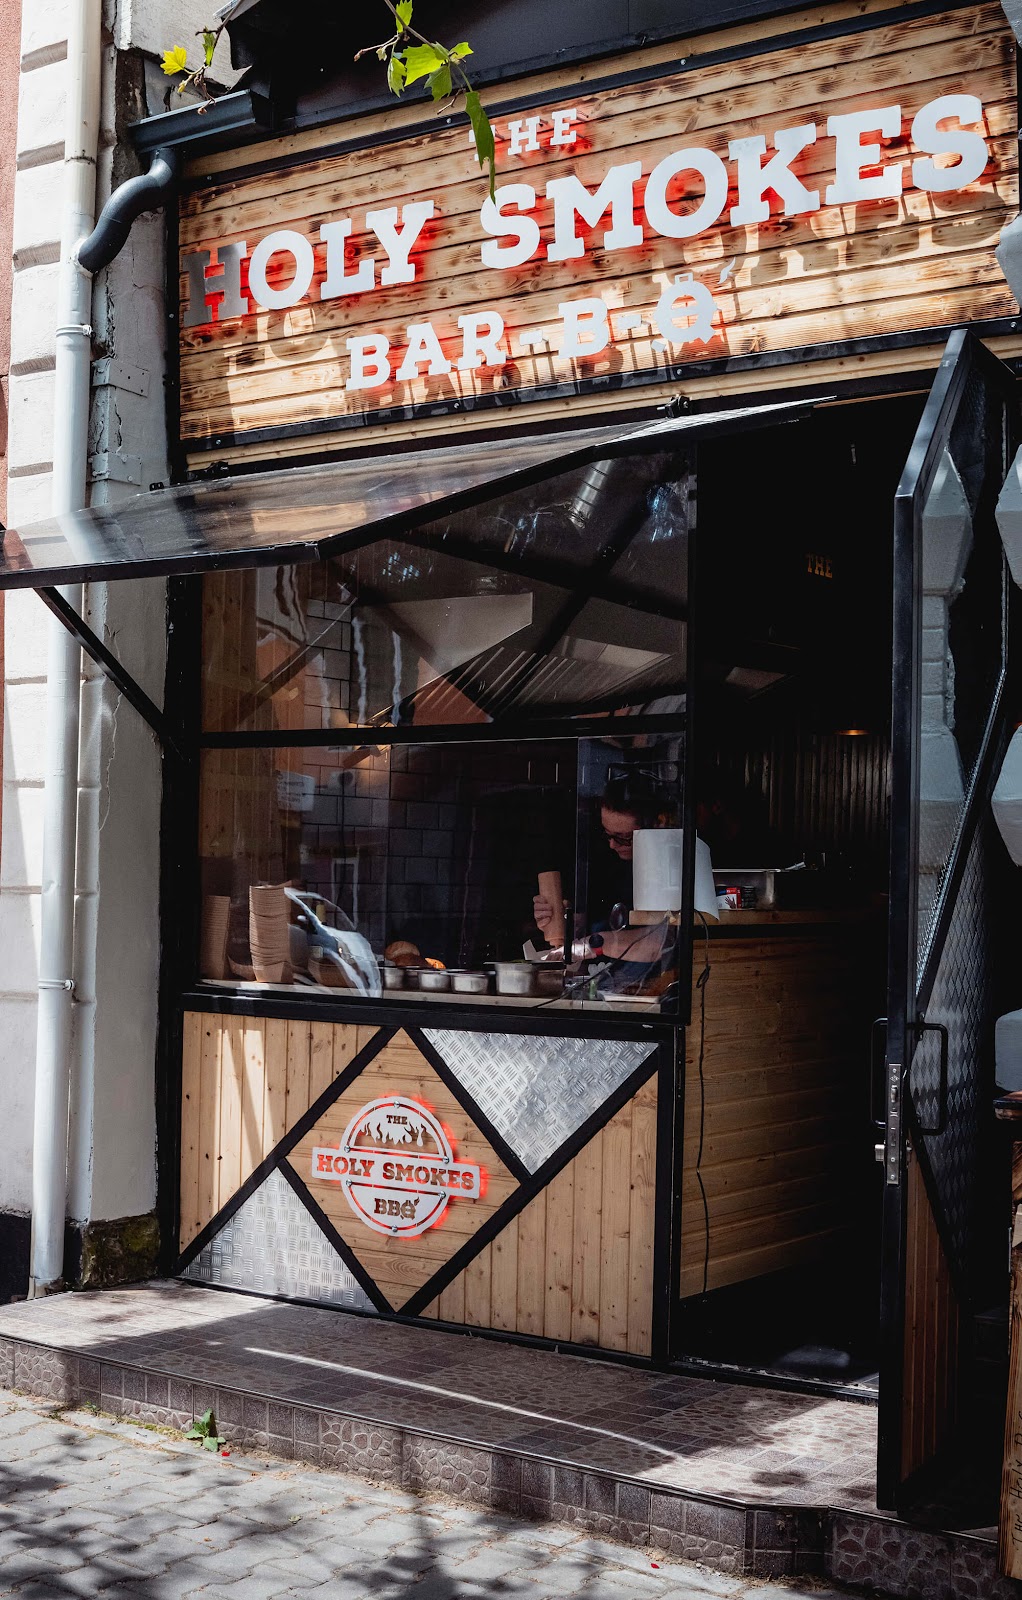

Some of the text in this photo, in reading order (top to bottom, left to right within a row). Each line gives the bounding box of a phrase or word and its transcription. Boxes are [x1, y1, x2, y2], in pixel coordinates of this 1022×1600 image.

[182, 94, 989, 328] HOLY SMOKES
[804, 552, 832, 579] THE
[386, 1114, 408, 1126] THE
[316, 1153, 475, 1190] HOLY SMOKES
[373, 1197, 418, 1220] BBQ
